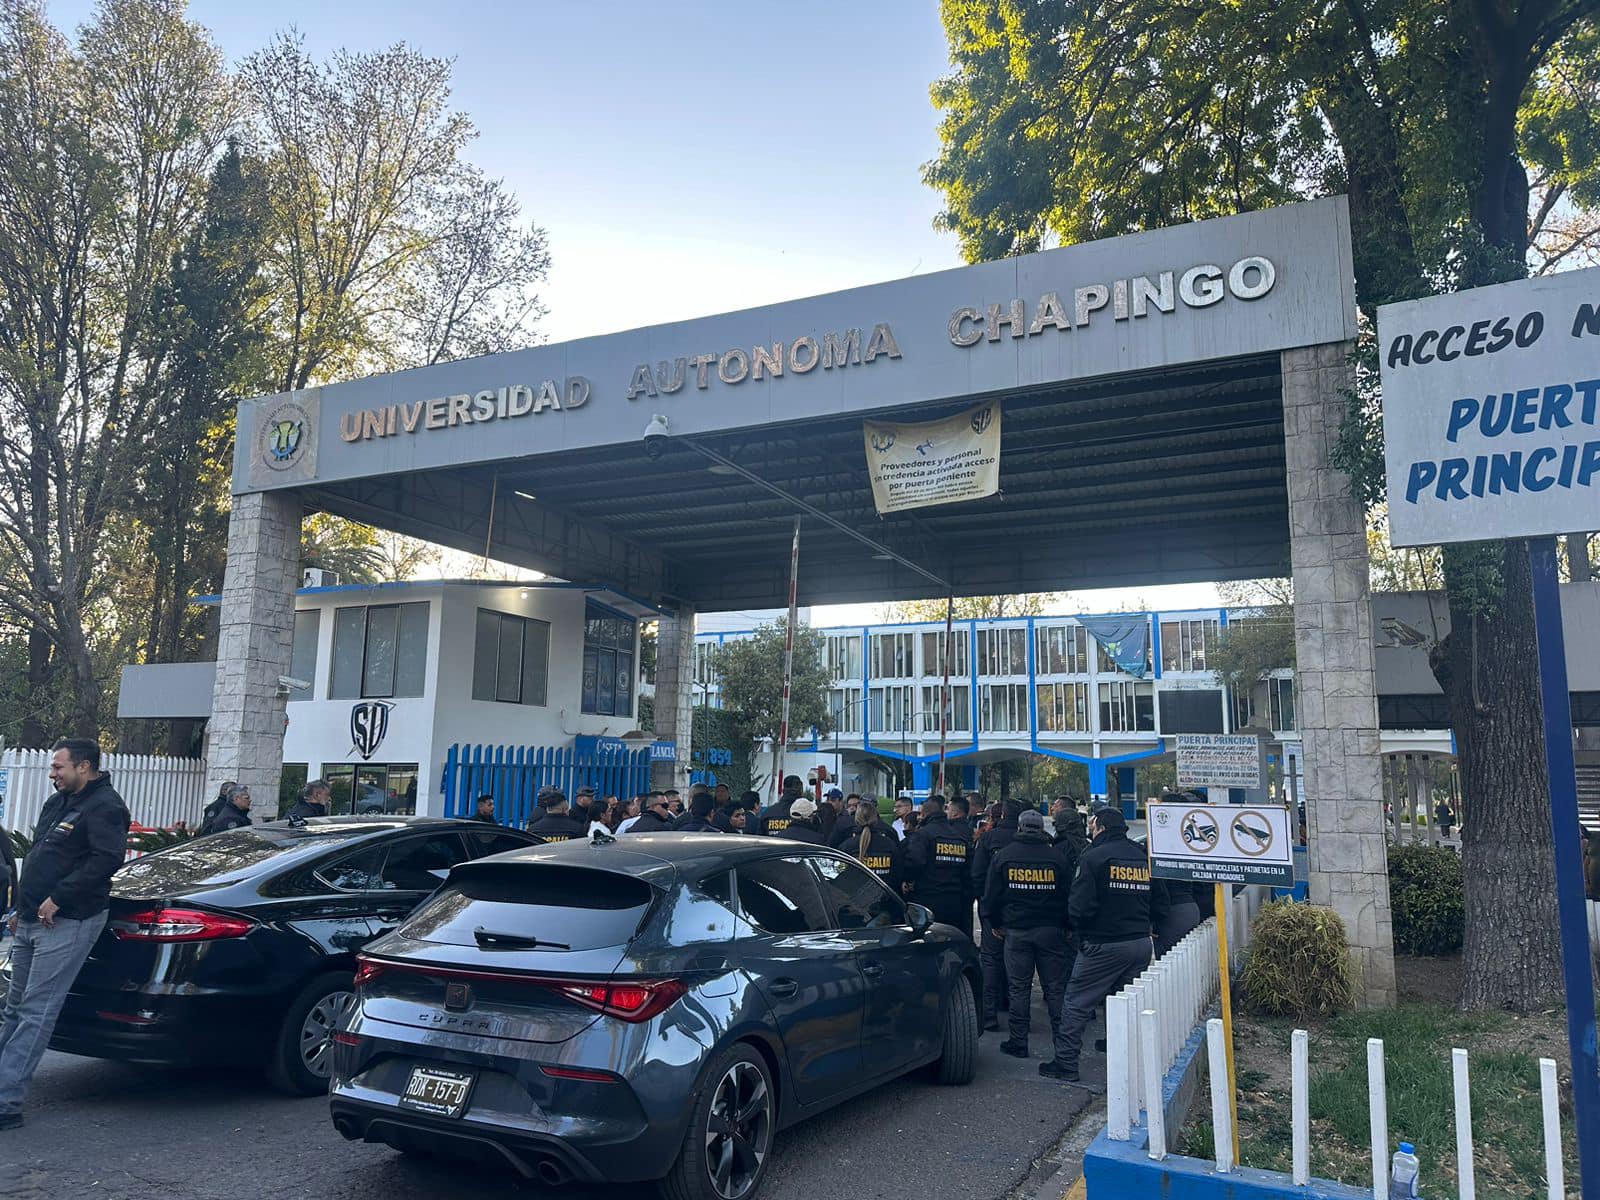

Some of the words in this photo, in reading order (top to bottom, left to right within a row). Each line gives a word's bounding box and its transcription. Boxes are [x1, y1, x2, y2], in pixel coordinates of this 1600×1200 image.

[339, 376, 591, 442] UNIVERSIDAD
[626, 322, 903, 401] AUTONOMA
[947, 255, 1277, 347] CHAPINGO
[1387, 311, 1544, 369] ACCESO
[1446, 379, 1600, 442] PUERT
[880, 459, 936, 471] Proveedores
[945, 448, 982, 464] personal
[964, 456, 996, 468] acceso
[1405, 440, 1600, 504] PRINCIP
[889, 482, 903, 492] por
[904, 478, 935, 490] puerta
[1178, 735, 1212, 745] PUERTA
[1214, 736, 1257, 745] PRINCIPAL
